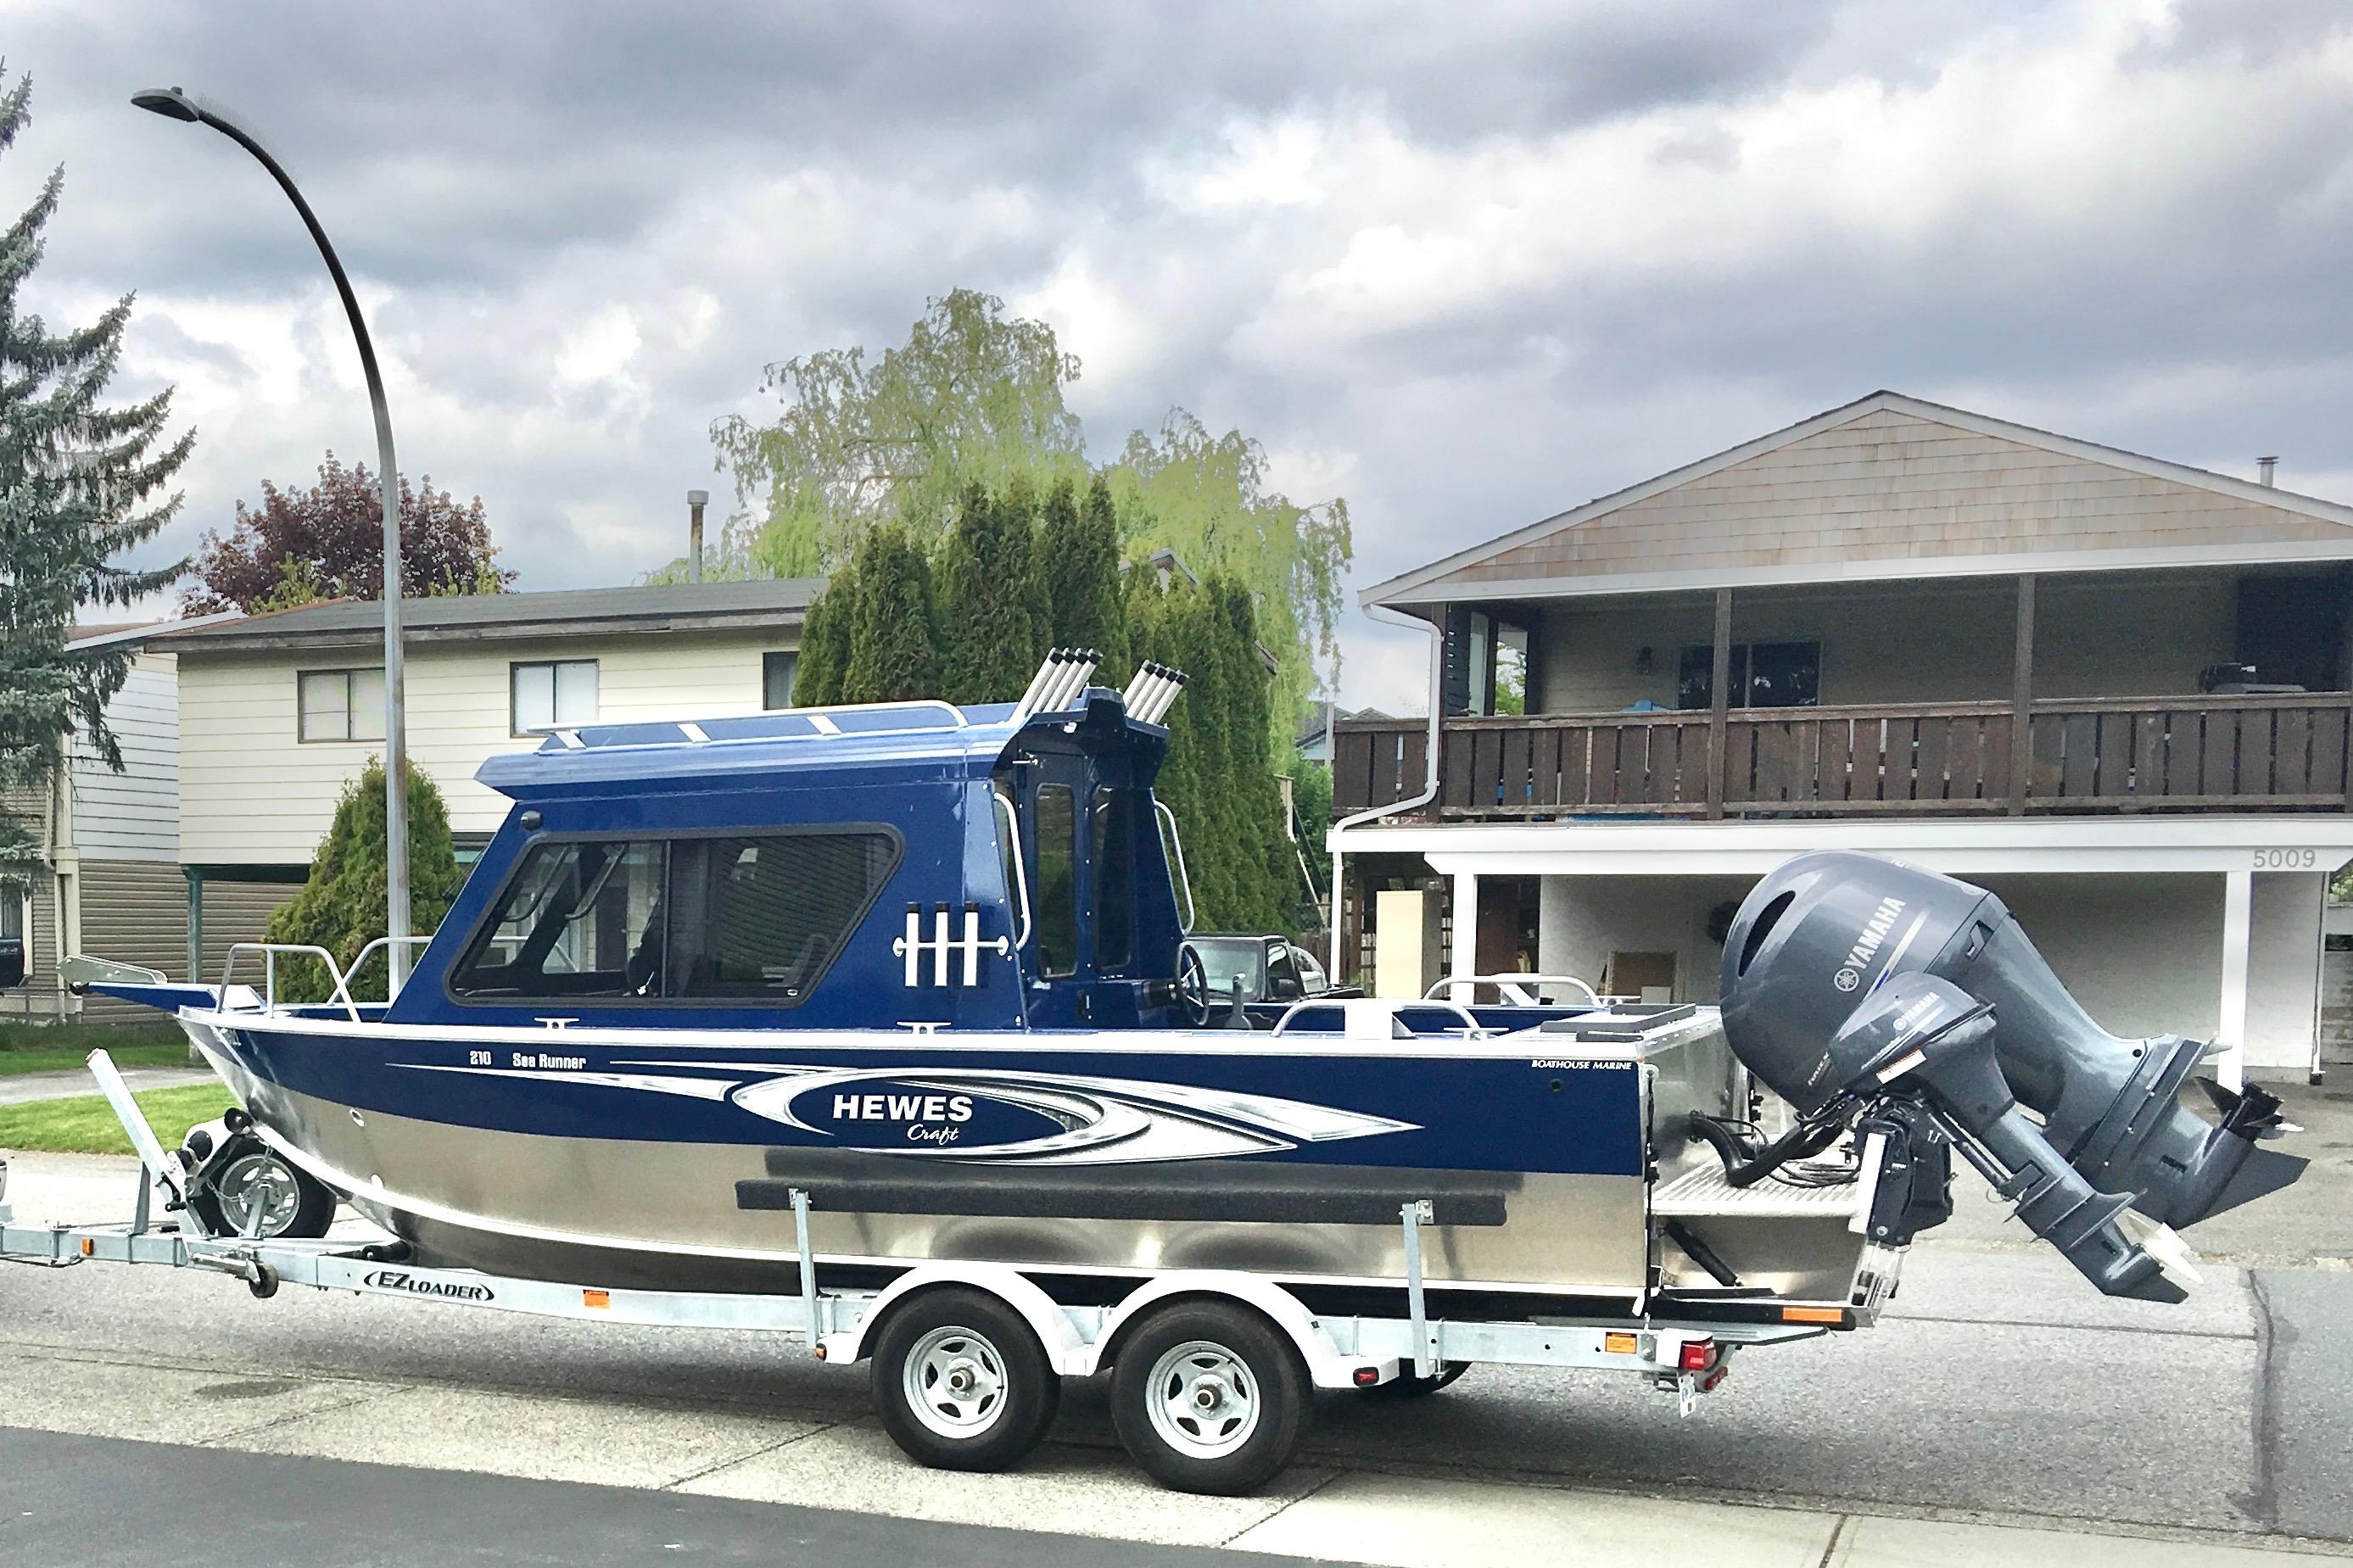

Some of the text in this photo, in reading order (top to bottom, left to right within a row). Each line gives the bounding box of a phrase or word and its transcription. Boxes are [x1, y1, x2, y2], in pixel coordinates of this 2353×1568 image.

[2253, 849, 2316, 868] 5009
[1843, 897, 1907, 969] YAMAHA
[1901, 991, 1941, 1023] YAMAHA
[469, 1050, 492, 1066] 210
[512, 1052, 587, 1069] Sea Runner
[1531, 1059, 1632, 1070] BOATHOUSE MARINE
[832, 1094, 973, 1122] HEWES
[907, 1123, 960, 1146] Craft
